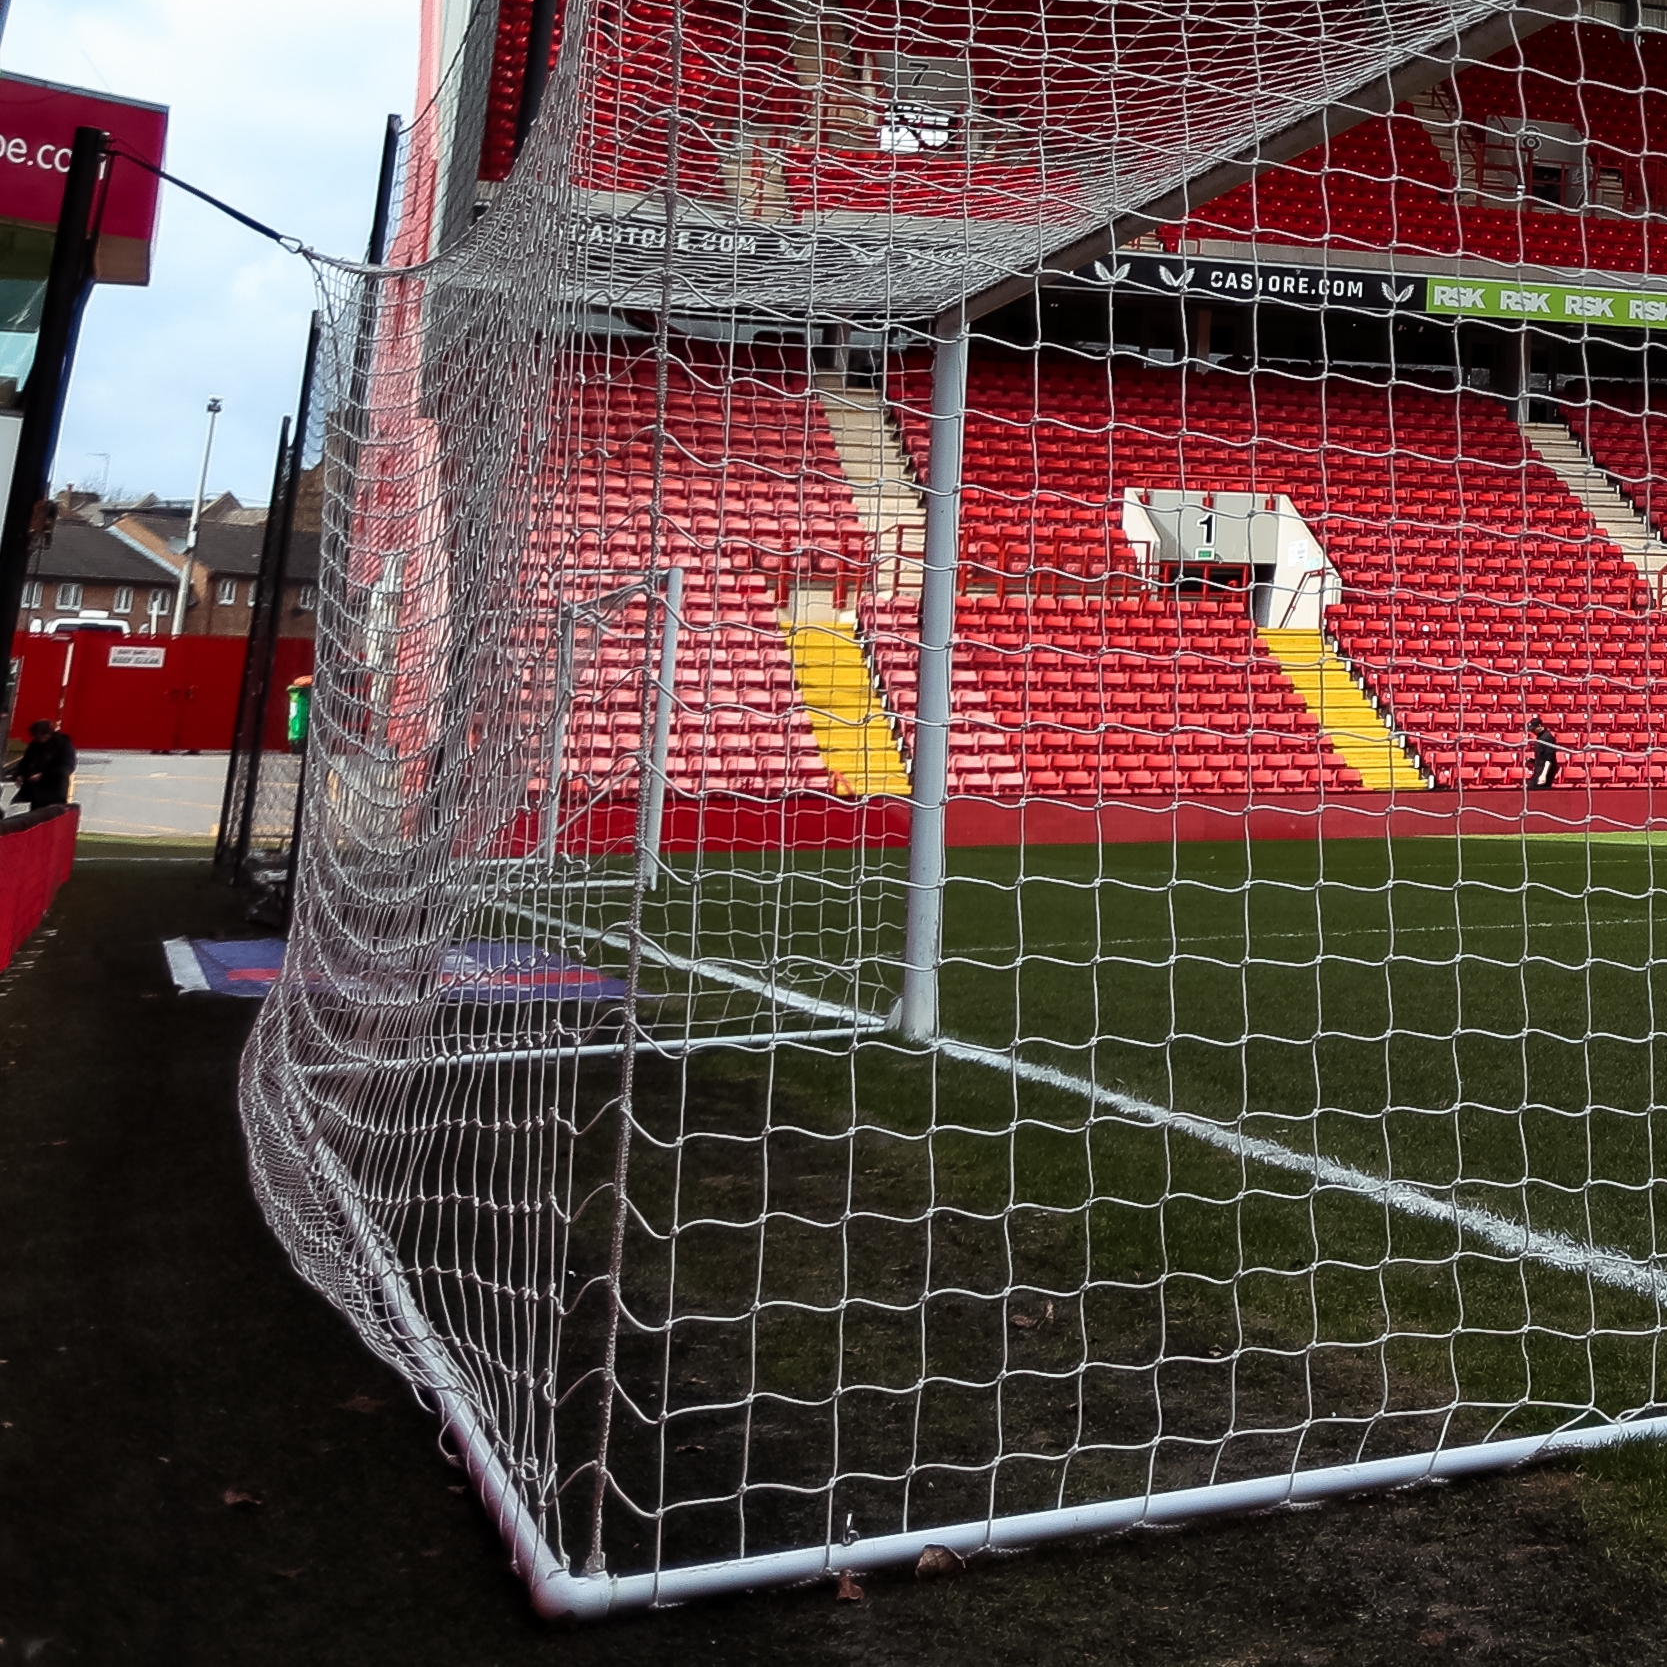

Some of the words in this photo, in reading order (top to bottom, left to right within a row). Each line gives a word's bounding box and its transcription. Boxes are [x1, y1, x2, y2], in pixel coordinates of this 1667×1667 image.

[907, 61, 930, 86] 7
[1434, 286, 1485, 309] RSK
[1500, 292, 1550, 314] RSK
[1565, 296, 1614, 318] RSK
[1199, 514, 1214, 544] 1
